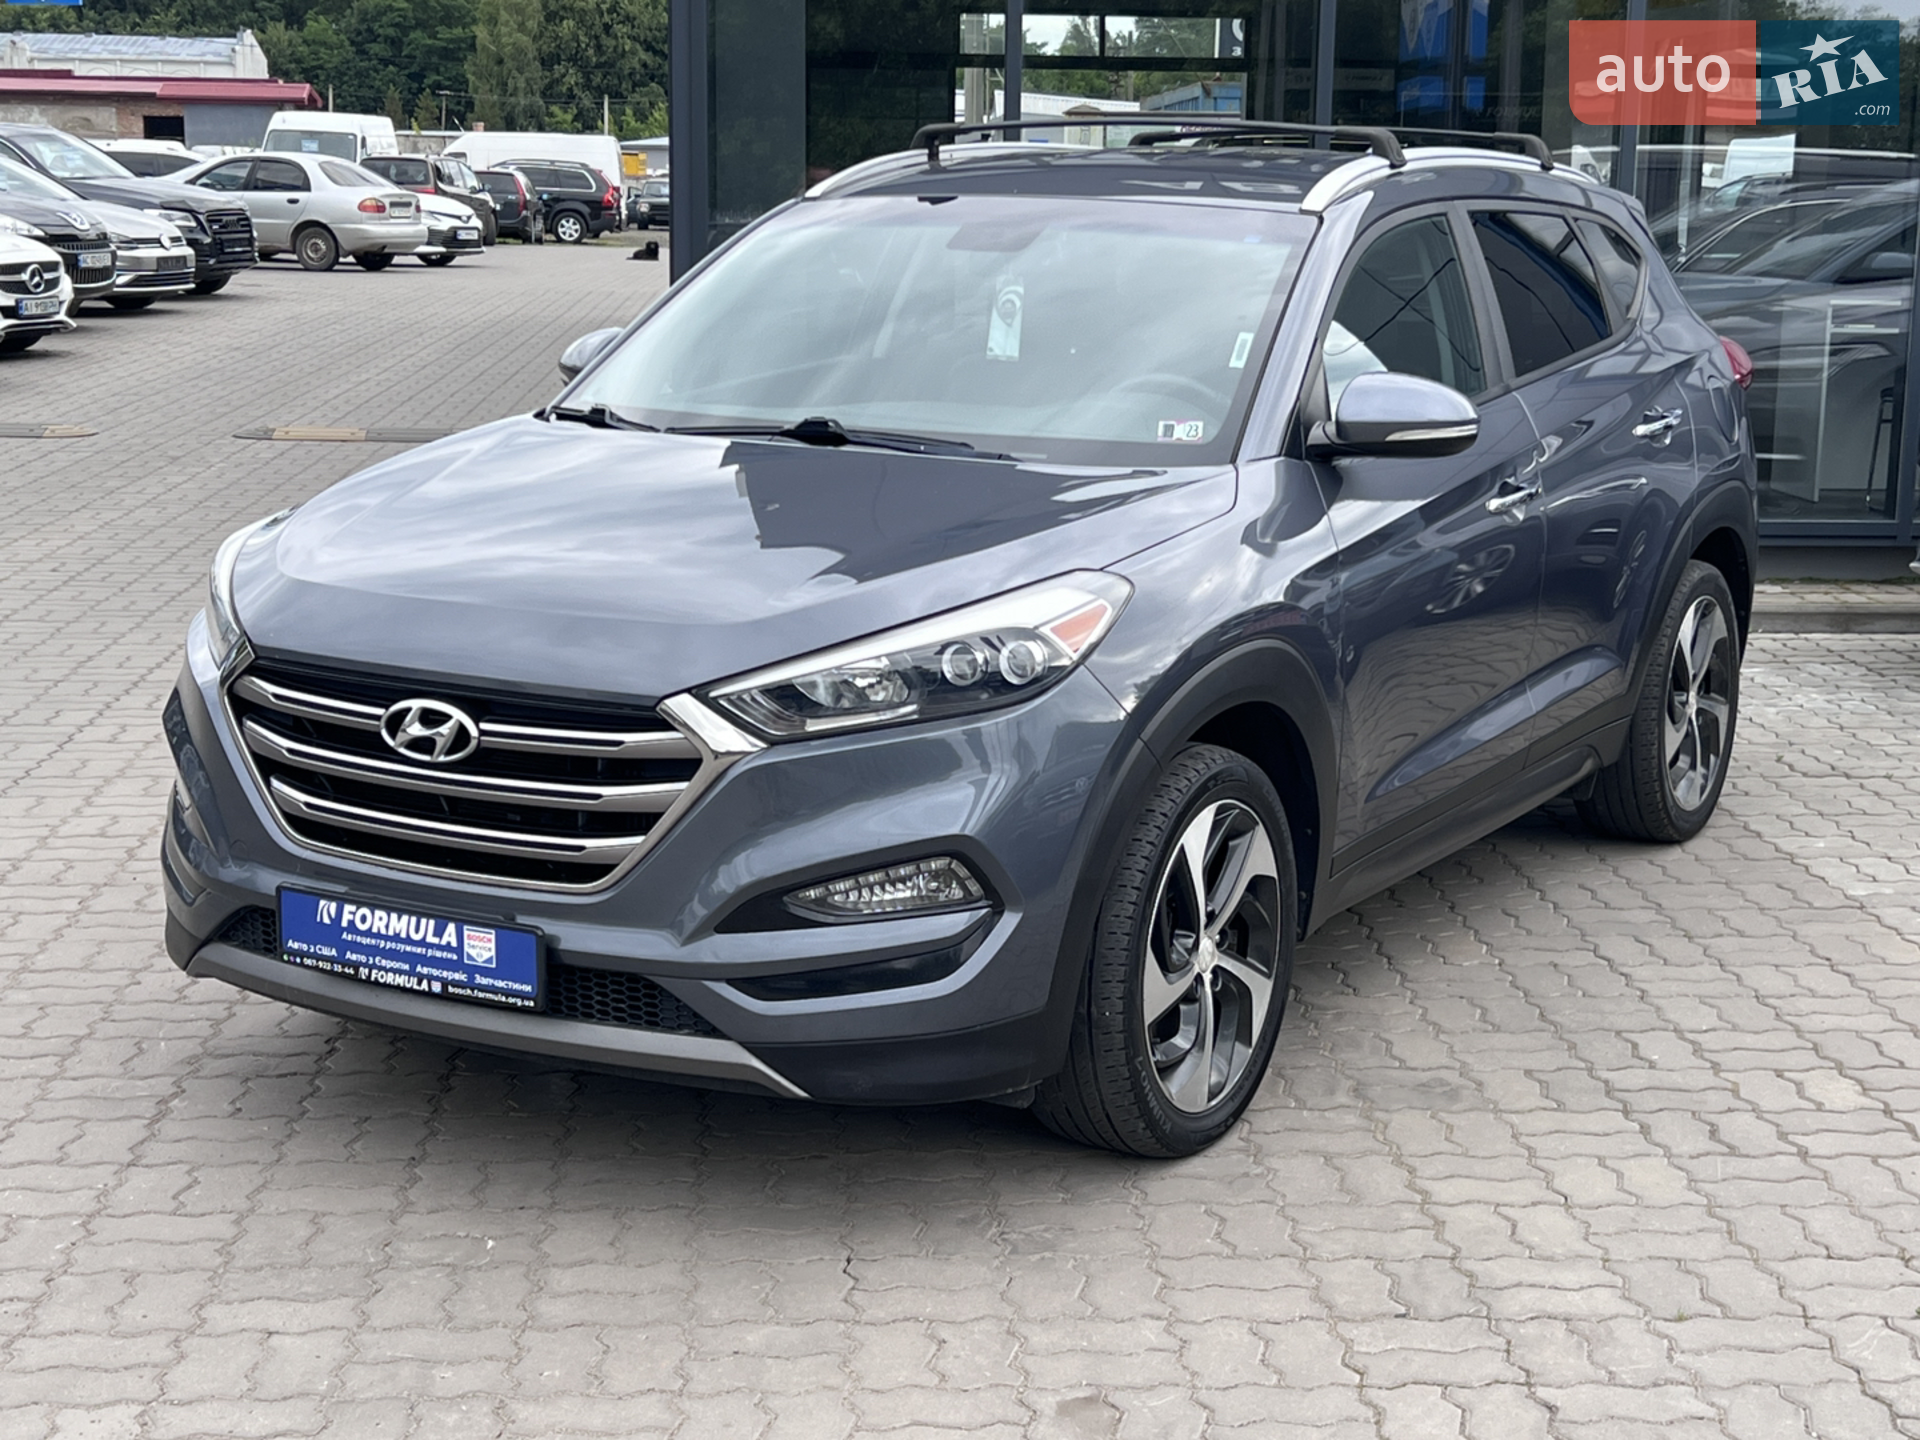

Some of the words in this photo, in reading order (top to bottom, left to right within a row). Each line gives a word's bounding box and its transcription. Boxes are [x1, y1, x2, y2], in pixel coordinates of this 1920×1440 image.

[1186, 424, 1200, 438] 23
[341, 903, 458, 948] FORMULA
[287, 939, 308, 952] Авто
[316, 944, 338, 957] США
[341, 931, 385, 949] Автоцентр
[385, 938, 426, 955] розумних
[427, 946, 458, 960] рішень
[467, 933, 492, 944] BOSCH
[467, 942, 492, 953] Service
[345, 950, 367, 963] Авто
[371, 968, 429, 991] FORMULA
[416, 963, 468, 982] Автосервіс
[474, 973, 533, 993] Запчастини
[448, 985, 535, 1007] bosch.formula.org.ua
